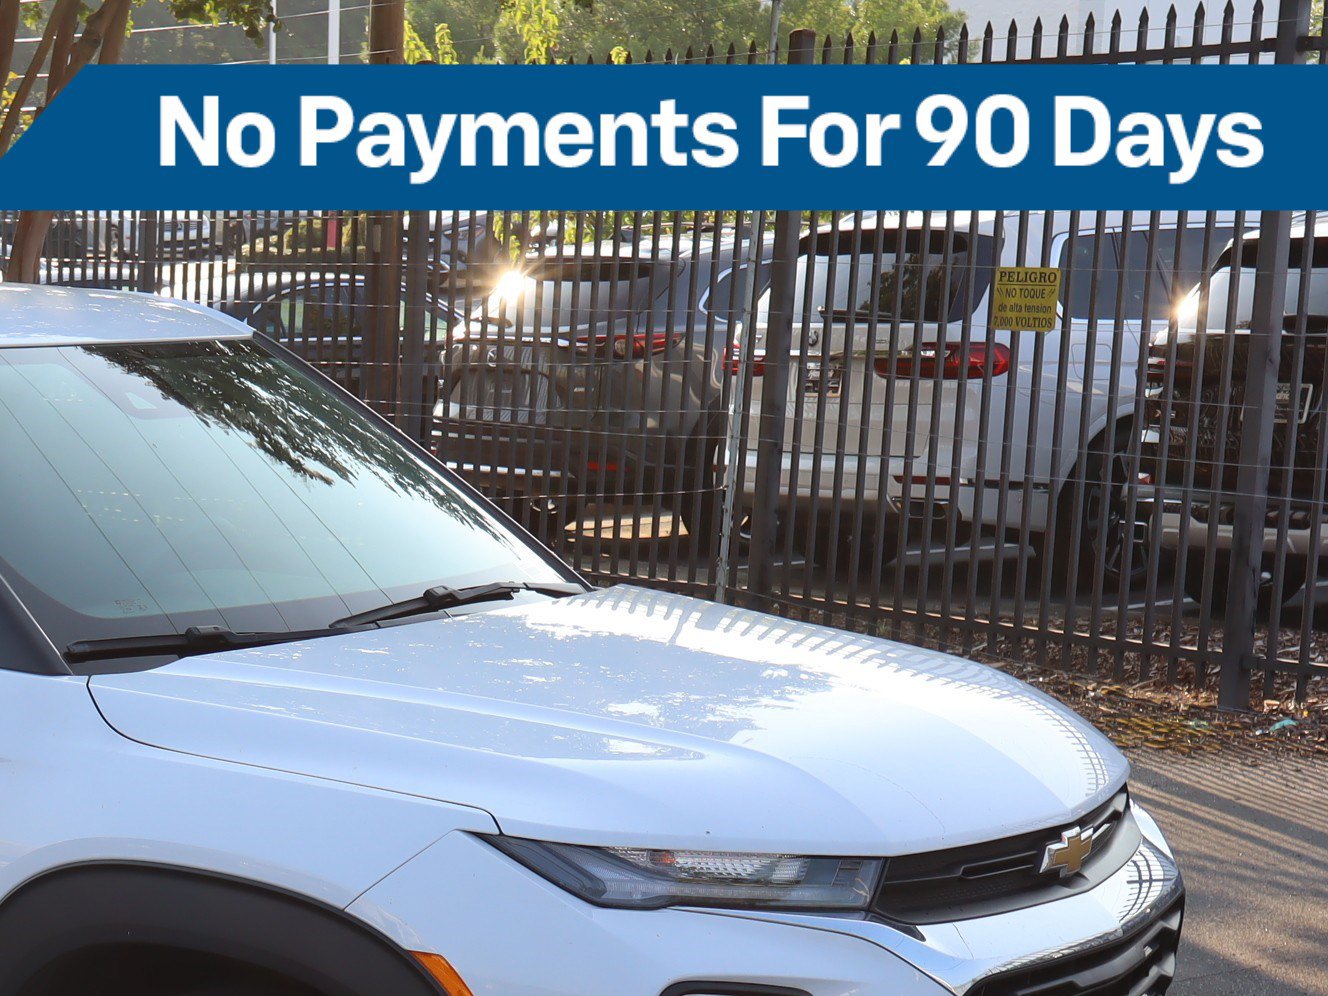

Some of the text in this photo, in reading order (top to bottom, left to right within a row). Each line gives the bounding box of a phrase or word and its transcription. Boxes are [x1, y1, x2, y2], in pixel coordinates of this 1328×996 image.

[999, 271, 1057, 283] PELIGRO
[1005, 288, 1046, 299] NO TOQUE
[998, 303, 1052, 314] de alta tension
[1015, 317, 1052, 328] VOLTIOS
